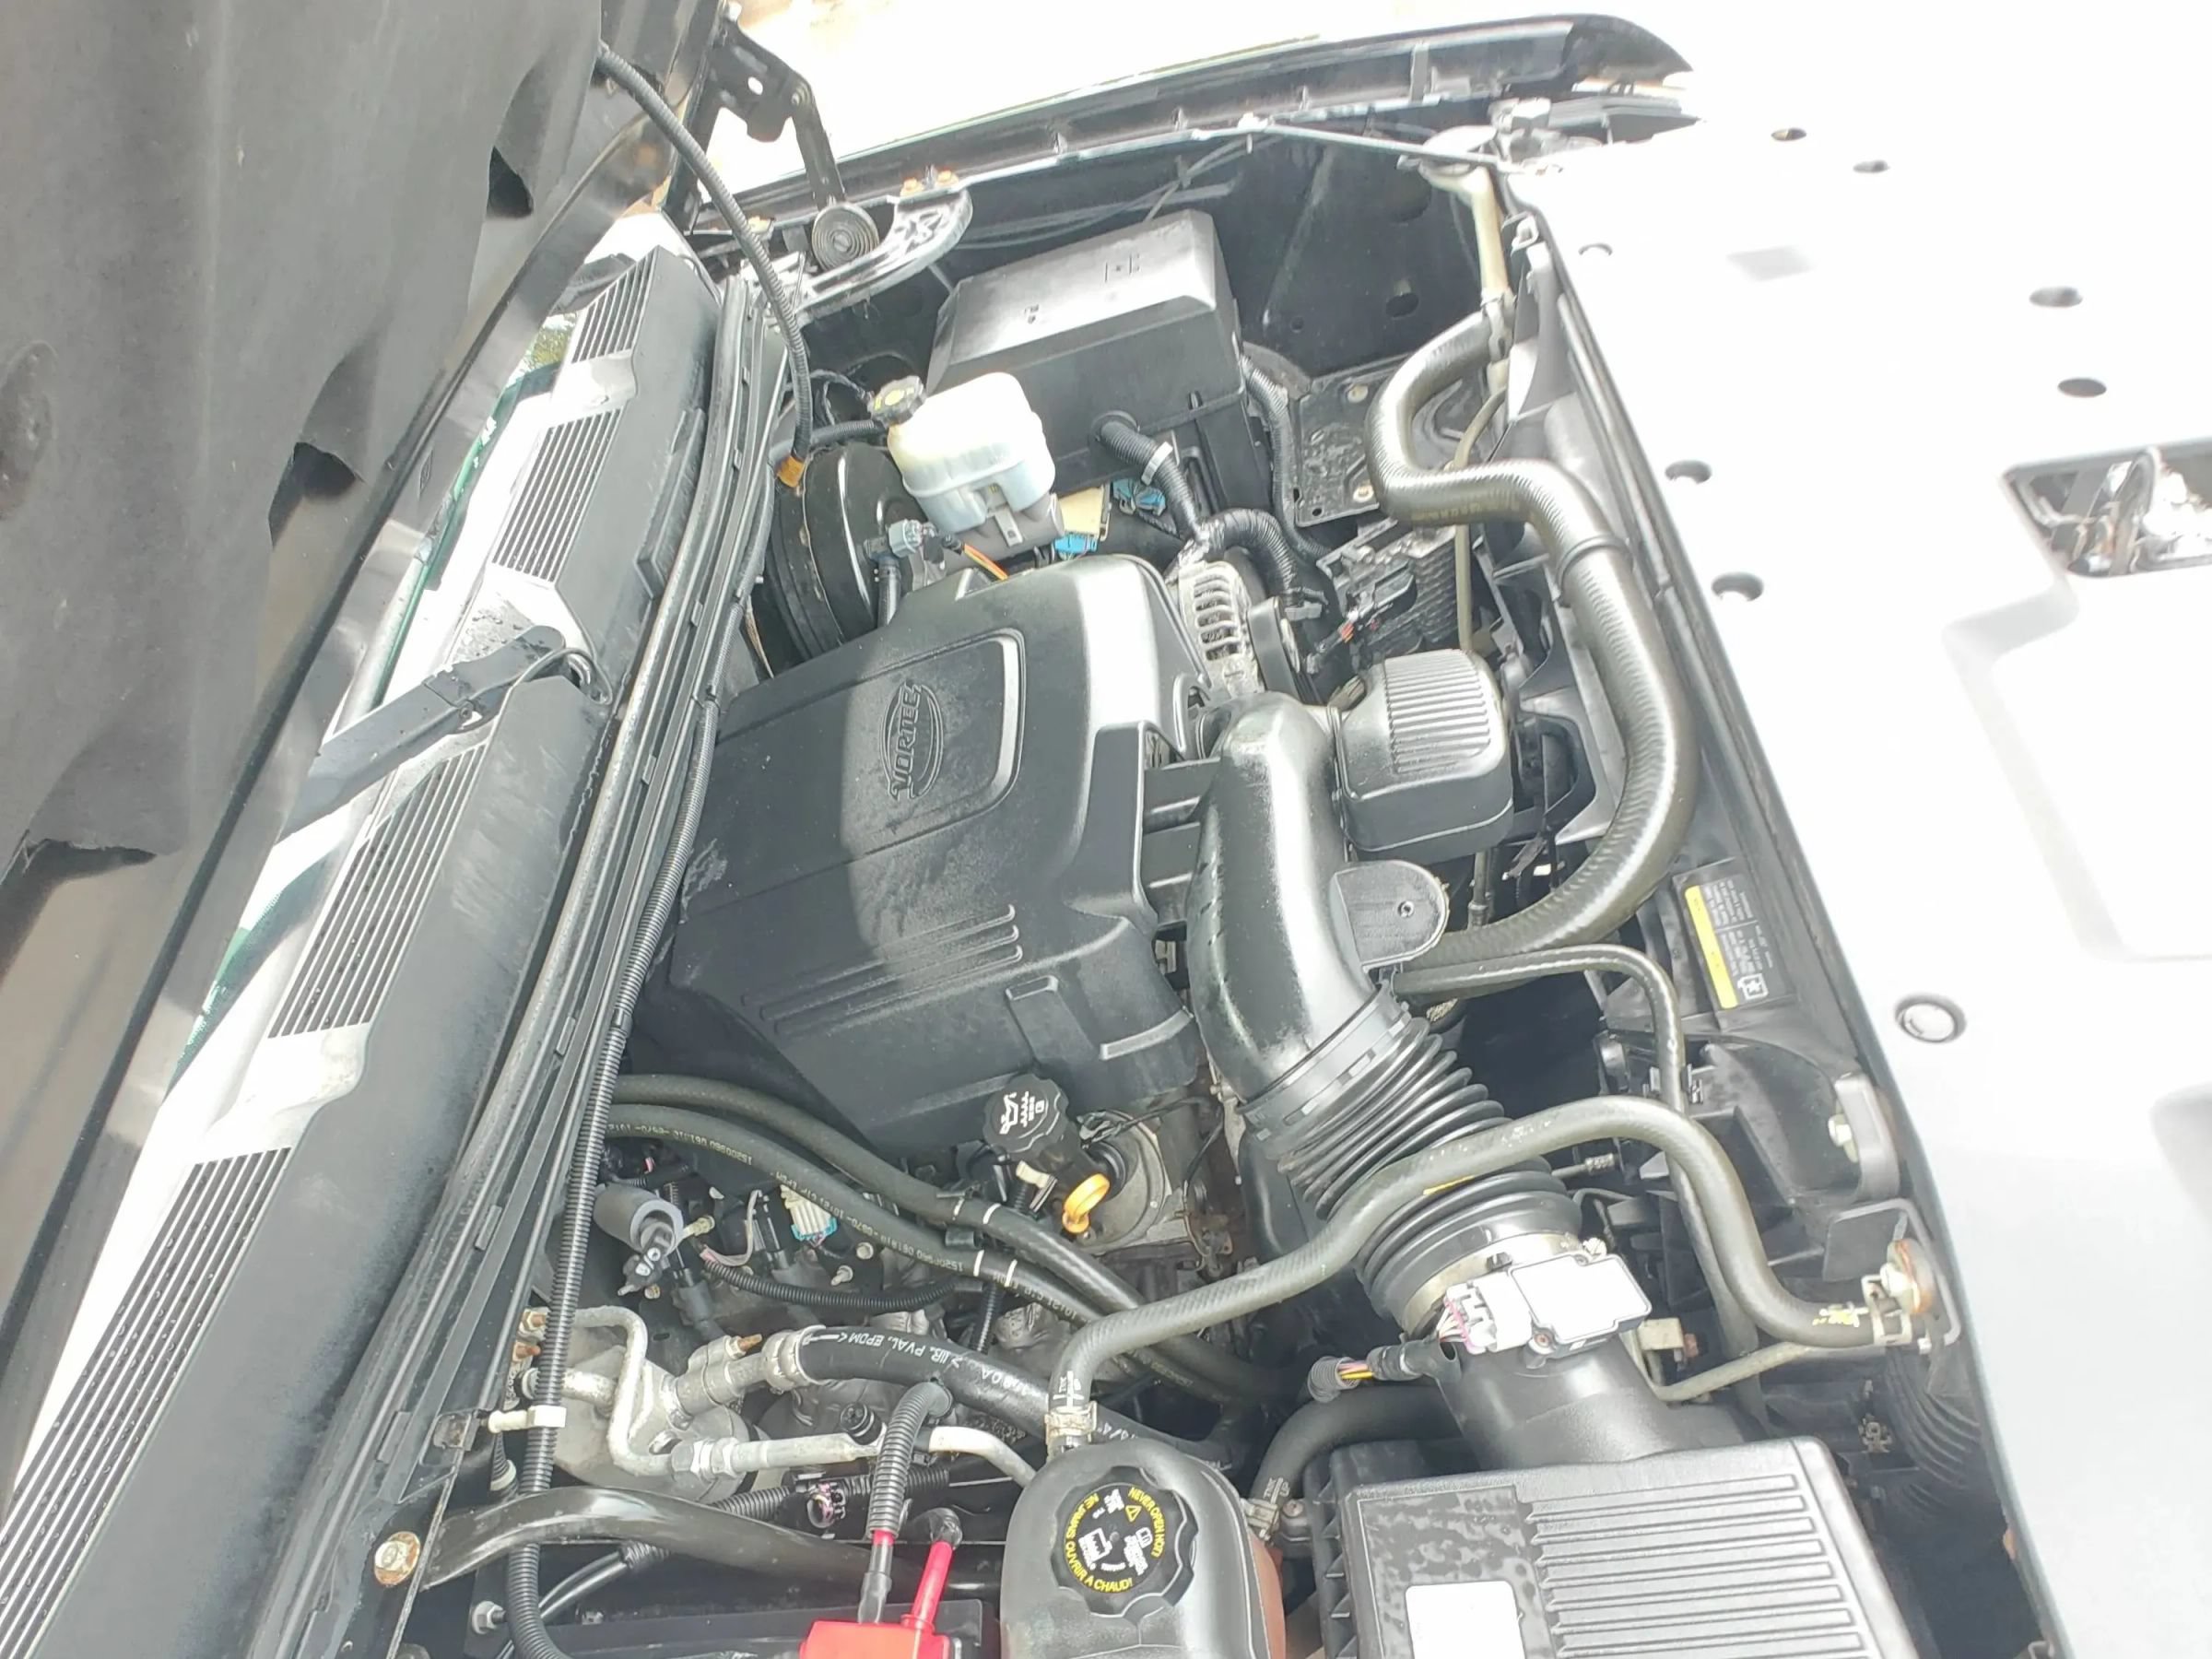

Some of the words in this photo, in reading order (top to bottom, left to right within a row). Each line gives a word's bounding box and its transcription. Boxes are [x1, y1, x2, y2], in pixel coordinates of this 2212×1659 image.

[1127, 1486, 1157, 1512] NEVER
[1149, 1506, 1165, 1534] OPEN
[1065, 1540, 1088, 1582] OUVRIR
